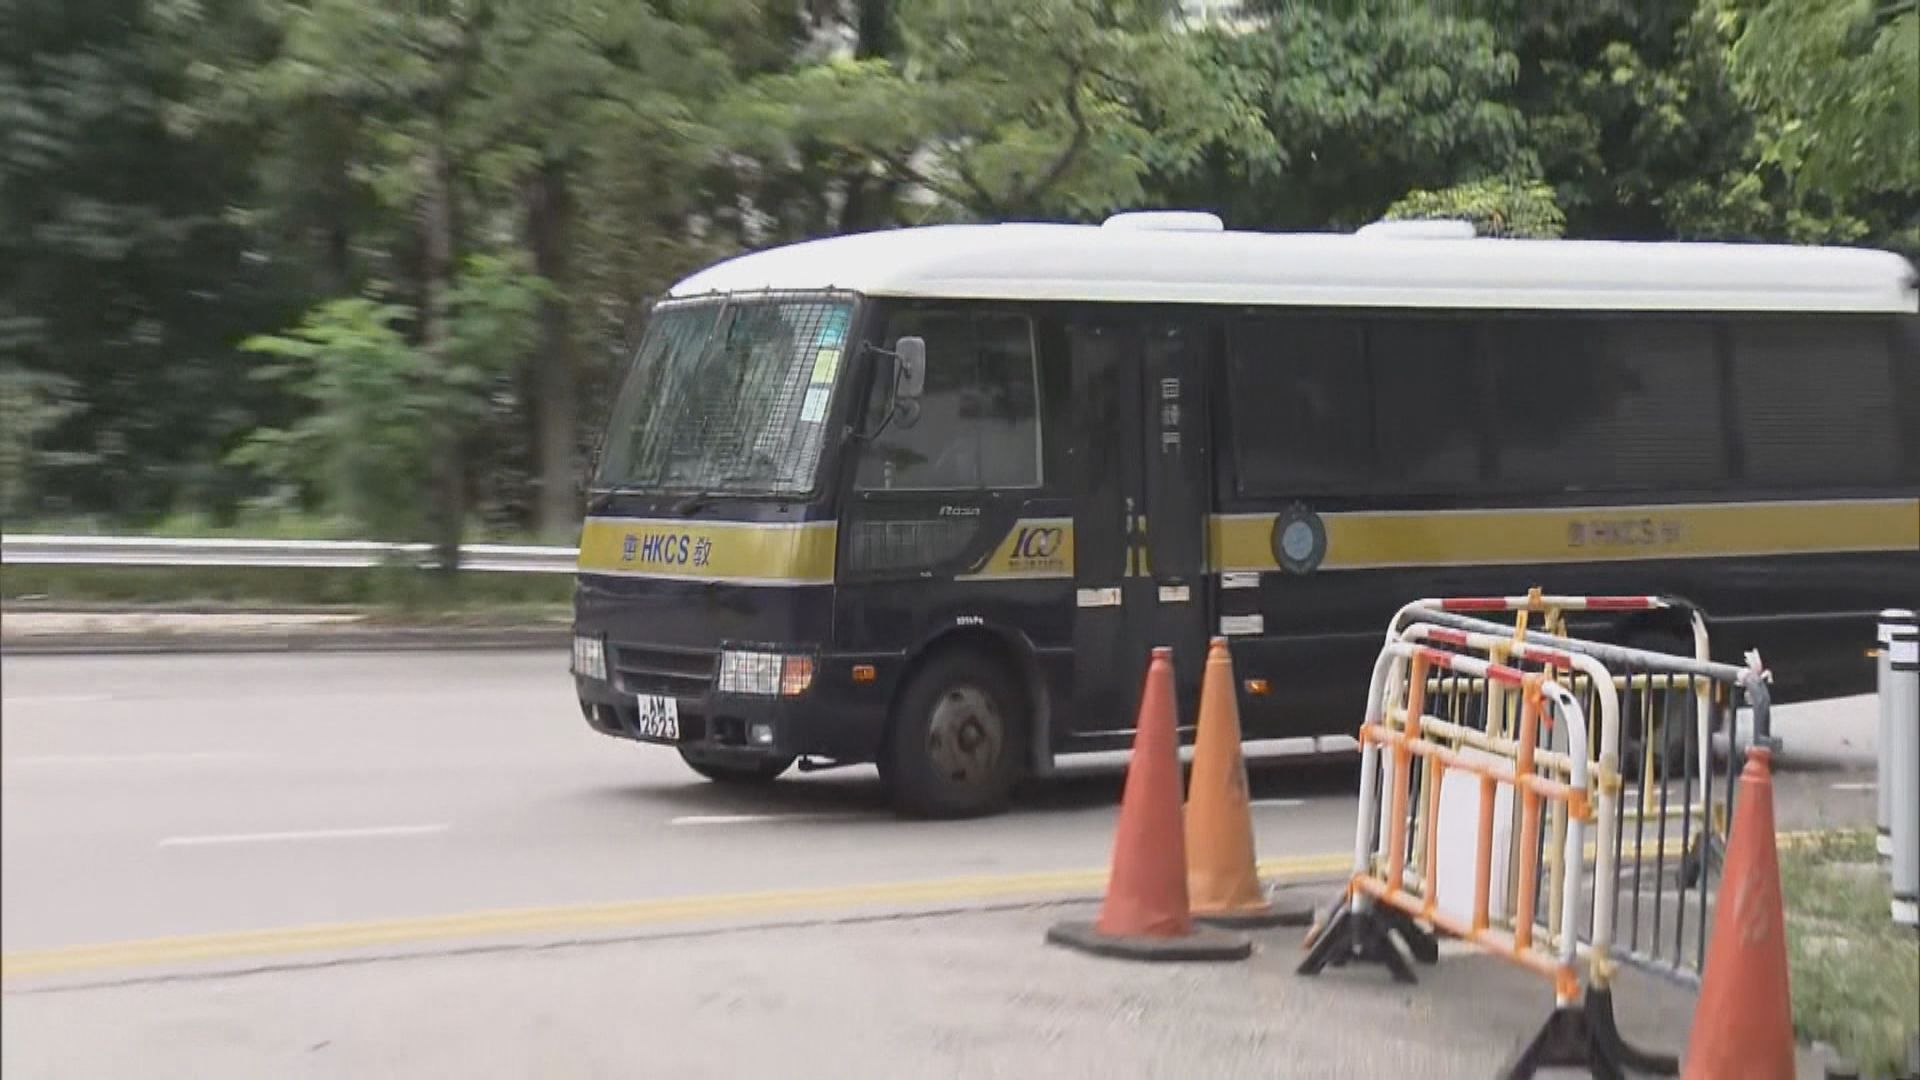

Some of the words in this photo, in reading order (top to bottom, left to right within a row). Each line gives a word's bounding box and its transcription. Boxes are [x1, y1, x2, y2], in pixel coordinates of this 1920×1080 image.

[641, 533, 690, 565] HKCS
[1009, 527, 1063, 558] 100
[650, 697, 666, 716] AM
[641, 713, 677, 738] 2623
